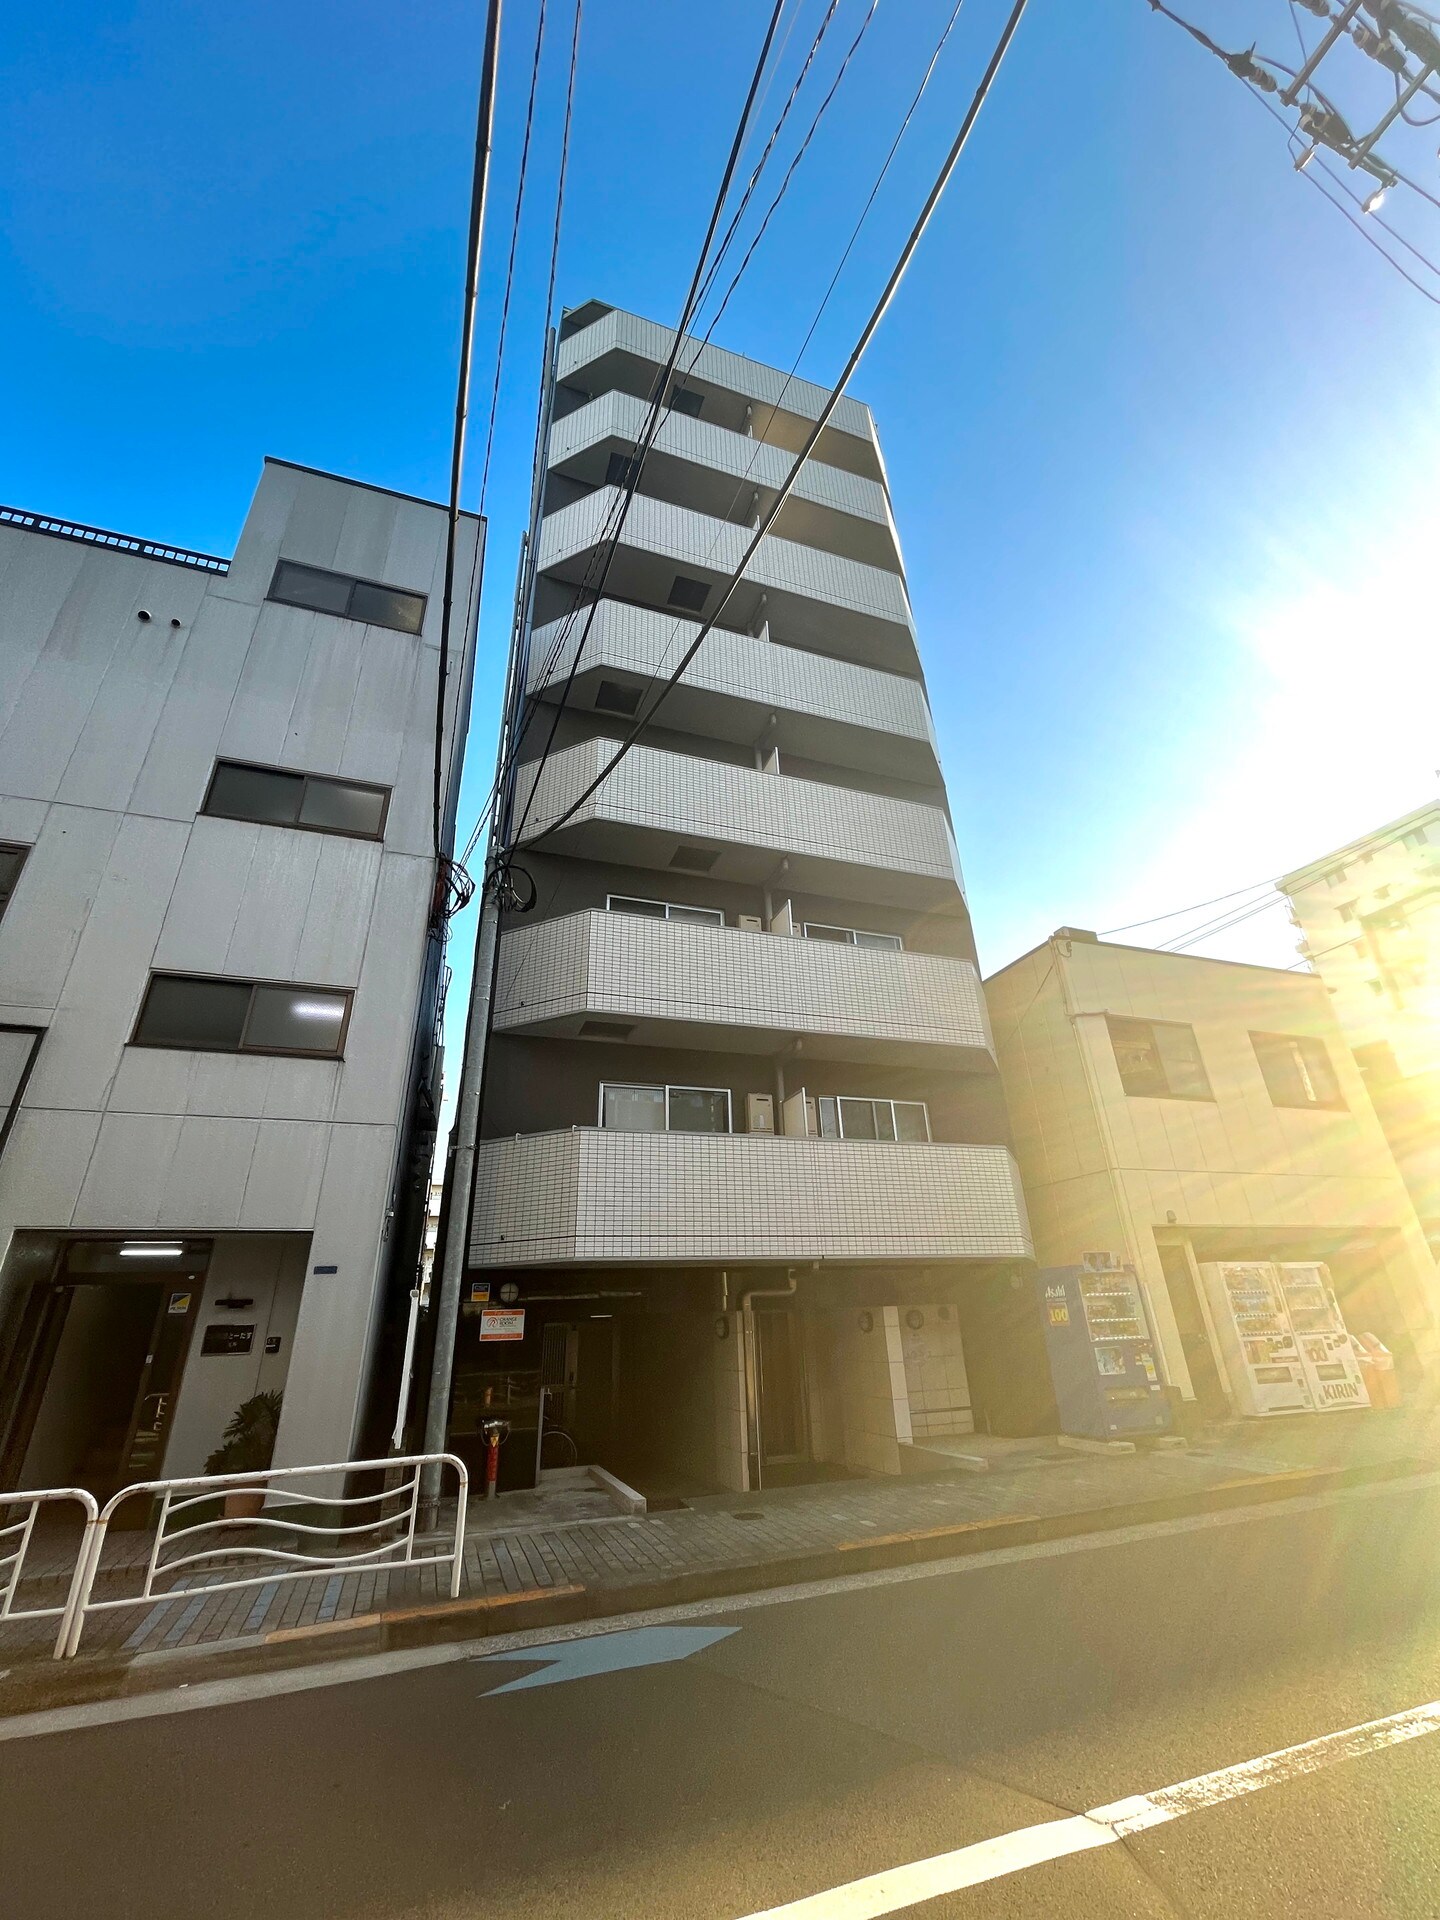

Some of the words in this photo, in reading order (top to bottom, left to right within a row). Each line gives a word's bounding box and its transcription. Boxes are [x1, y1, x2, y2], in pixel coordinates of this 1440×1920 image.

[1046, 1285, 1065, 1298] Asahi
[1050, 1309, 1068, 1322] 100
[1323, 1384, 1359, 1399] KIRIN
